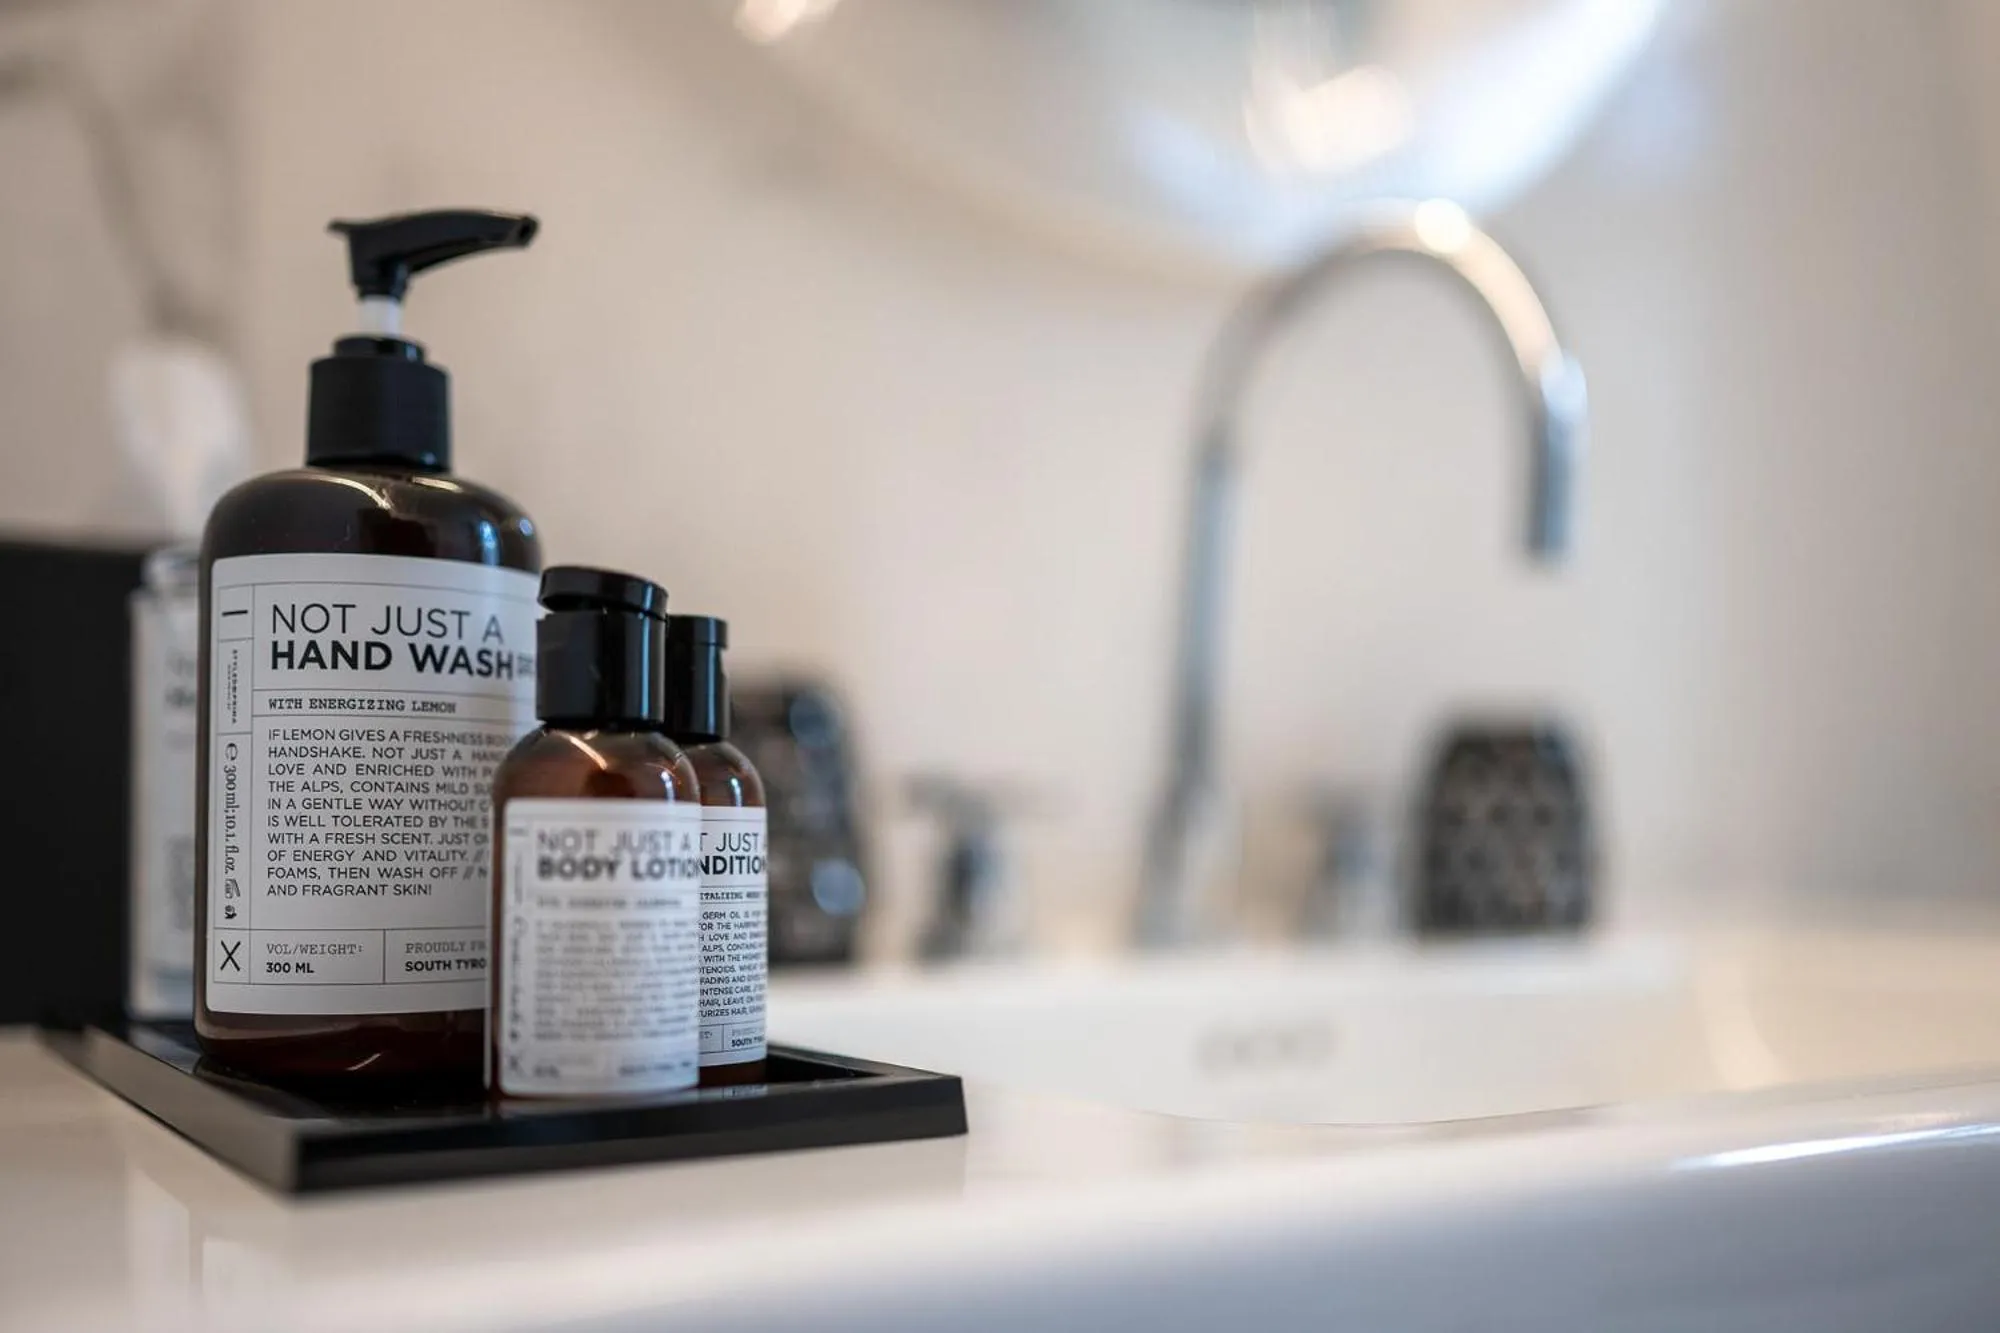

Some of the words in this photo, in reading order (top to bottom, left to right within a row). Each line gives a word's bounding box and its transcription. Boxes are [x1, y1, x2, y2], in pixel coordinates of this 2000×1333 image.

[272, 603, 356, 635] NOT
[371, 604, 471, 641] JUST
[482, 614, 504, 644] A
[271, 639, 392, 671] HAND
[408, 642, 514, 680] WASH
[268, 697, 302, 710] WITH
[308, 698, 405, 712] ENERGIZING
[411, 700, 456, 714] LEMON
[268, 728, 280, 741] IF
[283, 728, 336, 741] LEMON
[338, 729, 386, 742] GIVES
[388, 729, 400, 742] A
[403, 730, 483, 746] FRESHNESS
[267, 745, 366, 759] HANDSHAKE.
[372, 746, 405, 760] NOT
[410, 747, 447, 761] JUST
[452, 748, 463, 761] A
[268, 763, 305, 776] LOVE
[312, 763, 347, 776] AND
[355, 763, 434, 777] ENRICHED
[441, 764, 477, 779] WITH
[268, 780, 296, 793] THE
[300, 780, 344, 794] ALPS,
[350, 780, 430, 794] CONTAINS
[436, 781, 469, 796] MILD
[267, 797, 281, 810] IN
[286, 797, 297, 810] A
[301, 797, 363, 810] GENTLE
[368, 797, 404, 810] WAY
[408, 797, 475, 812] WITHOUT
[267, 815, 280, 827] IS
[283, 815, 326, 828] WELL
[331, 815, 424, 828] TOLERATED
[428, 815, 448, 828] BY
[453, 815, 479, 830] THE
[267, 832, 304, 845] WITH
[308, 832, 320, 845] A
[324, 832, 376, 845] FRESH
[380, 832, 433, 846] SCENT.
[438, 832, 470, 846] JUST
[537, 829, 597, 852] NOT
[612, 830, 673, 853] JUST
[680, 832, 692, 851] A
[715, 832, 759, 852] JUST
[267, 849, 287, 862] OF
[292, 849, 355, 862] ENERGY
[362, 849, 397, 862] AND
[267, 867, 321, 880] FOAMS,
[328, 866, 370, 879] THEN
[377, 866, 424, 879] WASH
[429, 866, 459, 879] OFF
[538, 855, 622, 880] BODY
[631, 857, 700, 881] LOTION
[267, 884, 298, 897] AND
[302, 884, 389, 897] FRAGRANT
[702, 911, 726, 920] GERM
[717, 921, 732, 930] THE
[708, 932, 729, 942] LOVE
[266, 942, 364, 956] VOL/WEIGHT:
[405, 941, 467, 954] PROUDLY
[703, 954, 725, 963] WITH
[727, 953, 741, 962] THE
[266, 961, 291, 974] 300
[295, 962, 314, 974] ML
[405, 959, 452, 972] SOUTH
[731, 975, 746, 983] AND
[700, 986, 733, 996] INTENSE
[723, 997, 744, 1006] LEAVE
